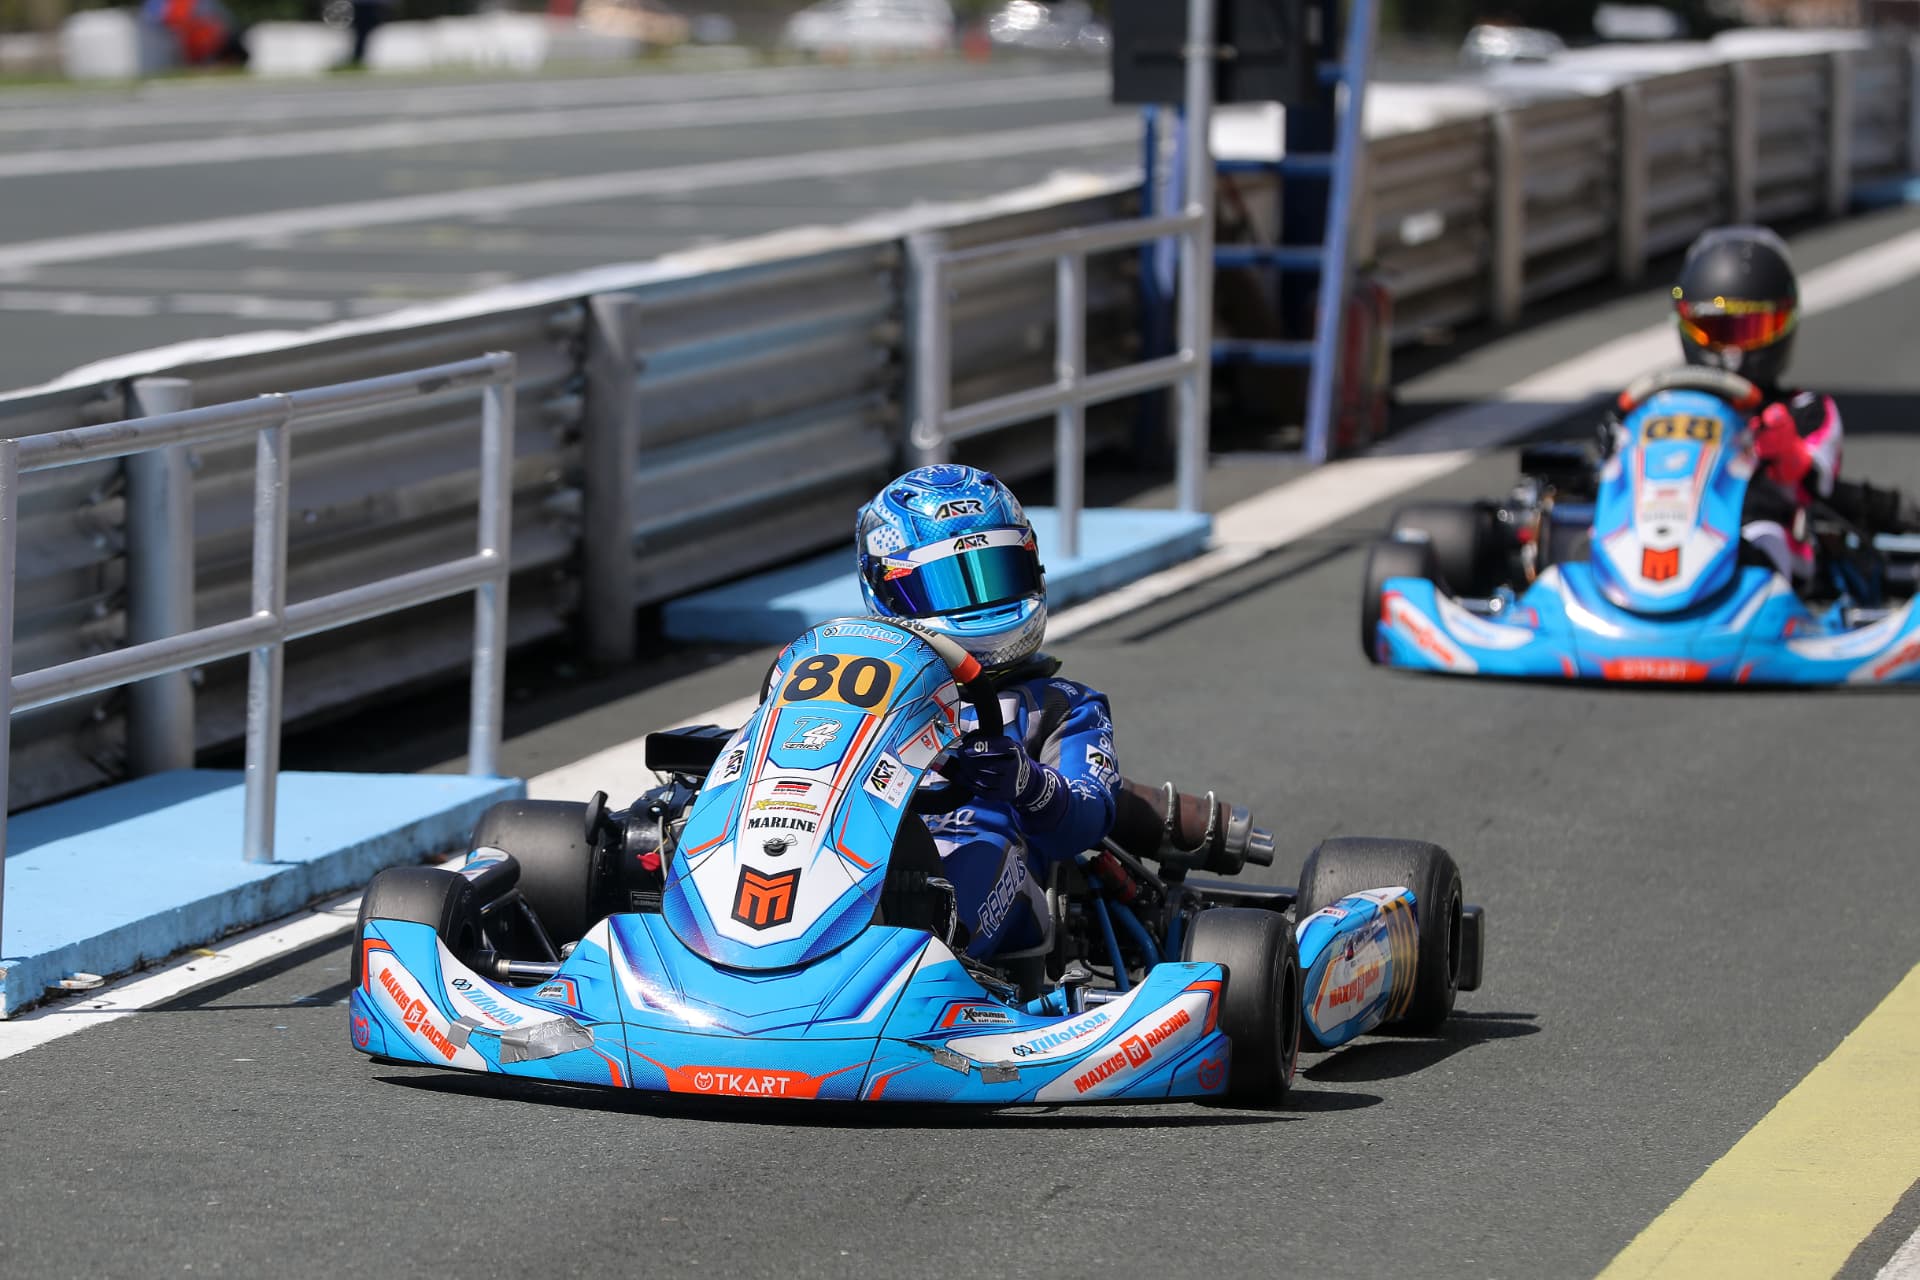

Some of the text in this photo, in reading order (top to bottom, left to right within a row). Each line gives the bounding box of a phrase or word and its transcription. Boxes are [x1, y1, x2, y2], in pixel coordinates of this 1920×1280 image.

[783, 654, 892, 708] 80
[747, 816, 817, 833] MARLINE
[379, 967, 458, 1061] MAXXIS RACING
[1028, 1012, 1108, 1051] Tillotson
[1074, 1052, 1127, 1094] MAXXIS
[1144, 1009, 1190, 1048] RACING
